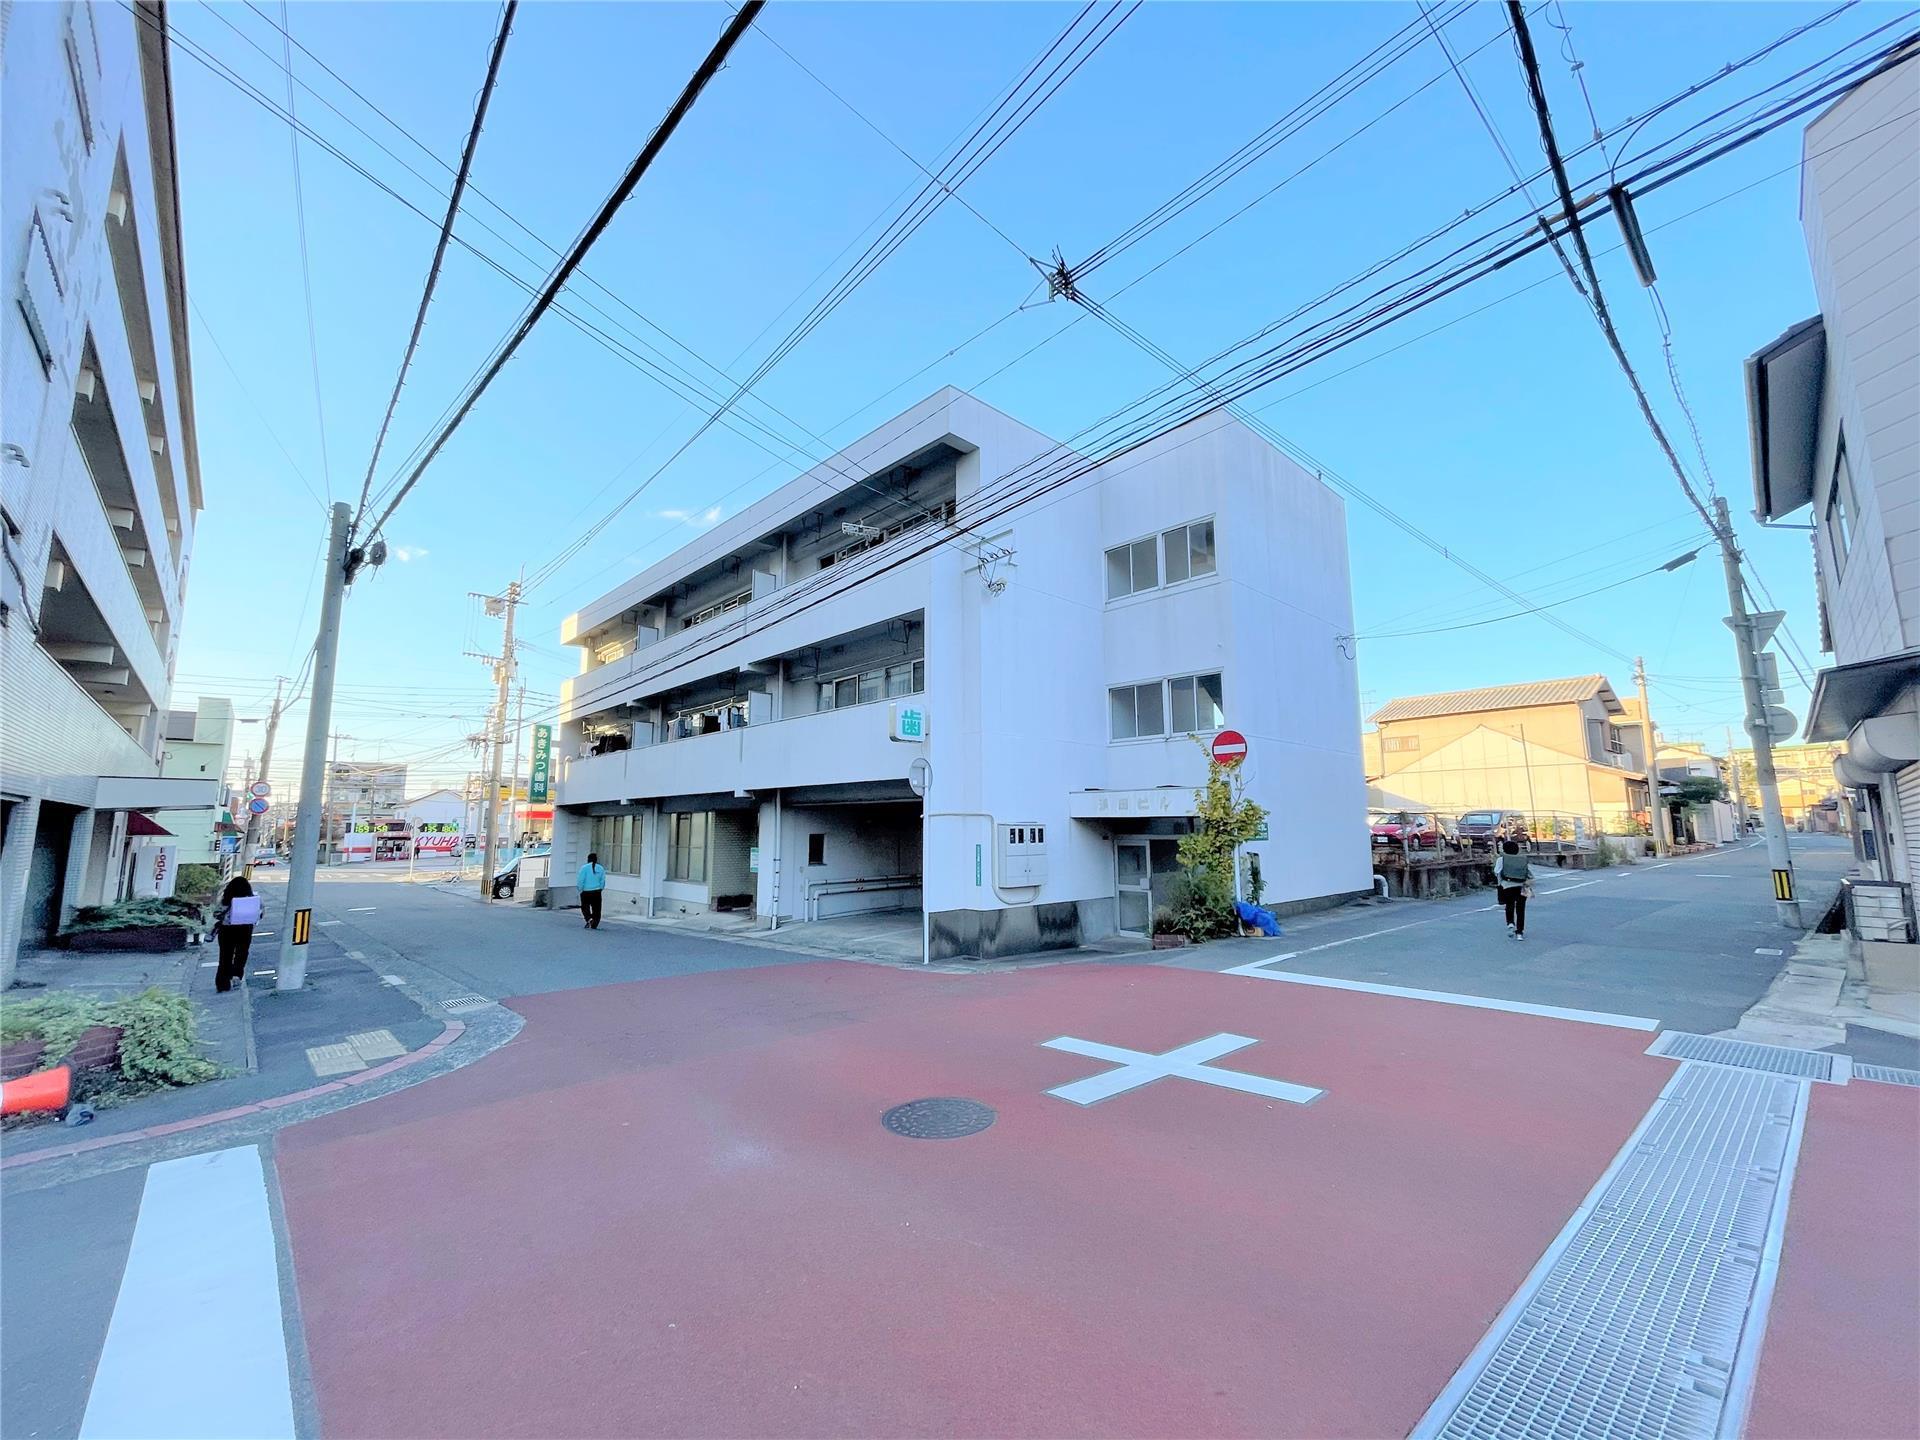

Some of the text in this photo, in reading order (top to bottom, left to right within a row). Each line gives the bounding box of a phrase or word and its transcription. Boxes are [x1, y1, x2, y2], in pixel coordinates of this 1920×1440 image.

[901, 709, 921, 737] 歯
[533, 727, 548, 793] あきみつ歯科
[155, 854, 167, 881] DyDo
